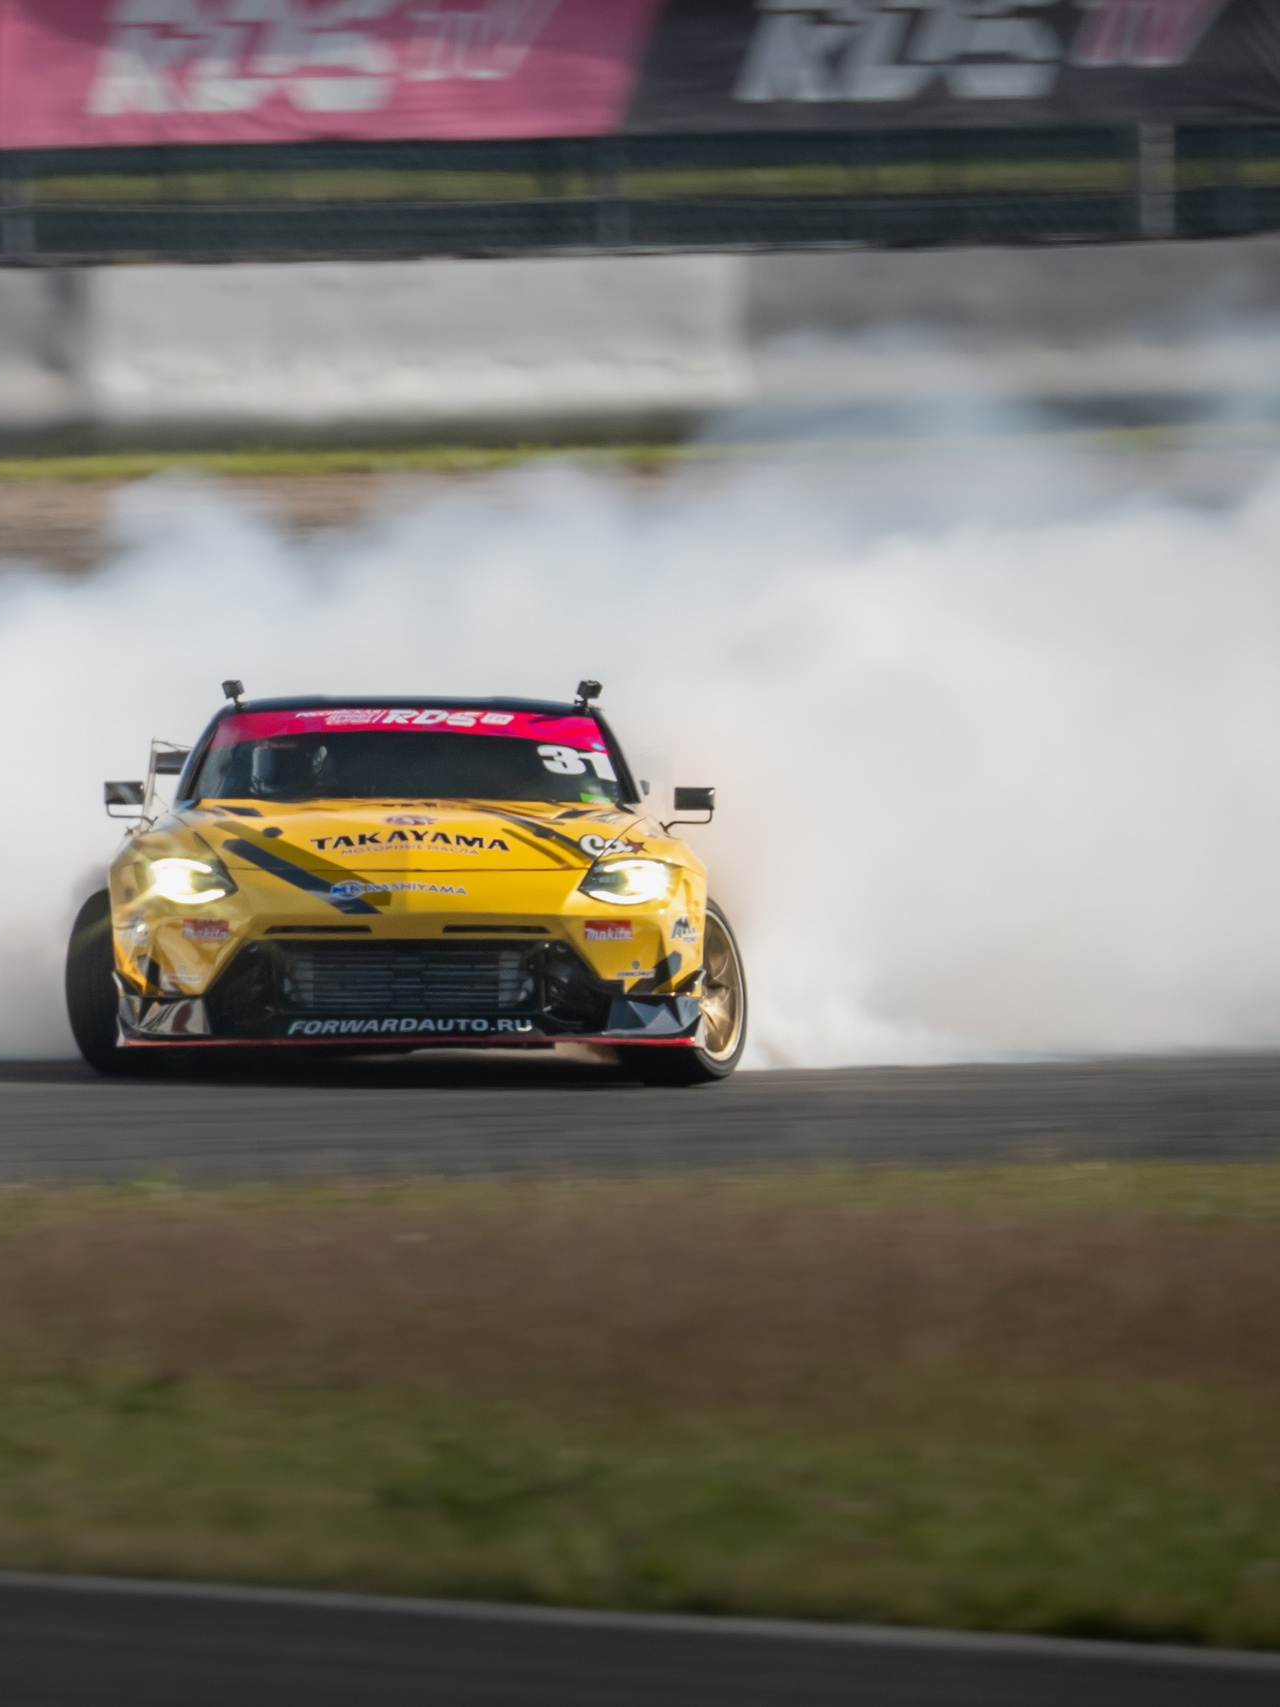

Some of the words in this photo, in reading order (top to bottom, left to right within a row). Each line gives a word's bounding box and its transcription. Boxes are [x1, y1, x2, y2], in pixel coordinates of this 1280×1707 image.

[381, 709, 484, 727] RDS
[537, 744, 618, 782] 31
[310, 830, 511, 851] TAKAYAMA
[366, 882, 467, 895] KASHIYAMA
[287, 1018, 533, 1035] FORWARDAUTO.RU
